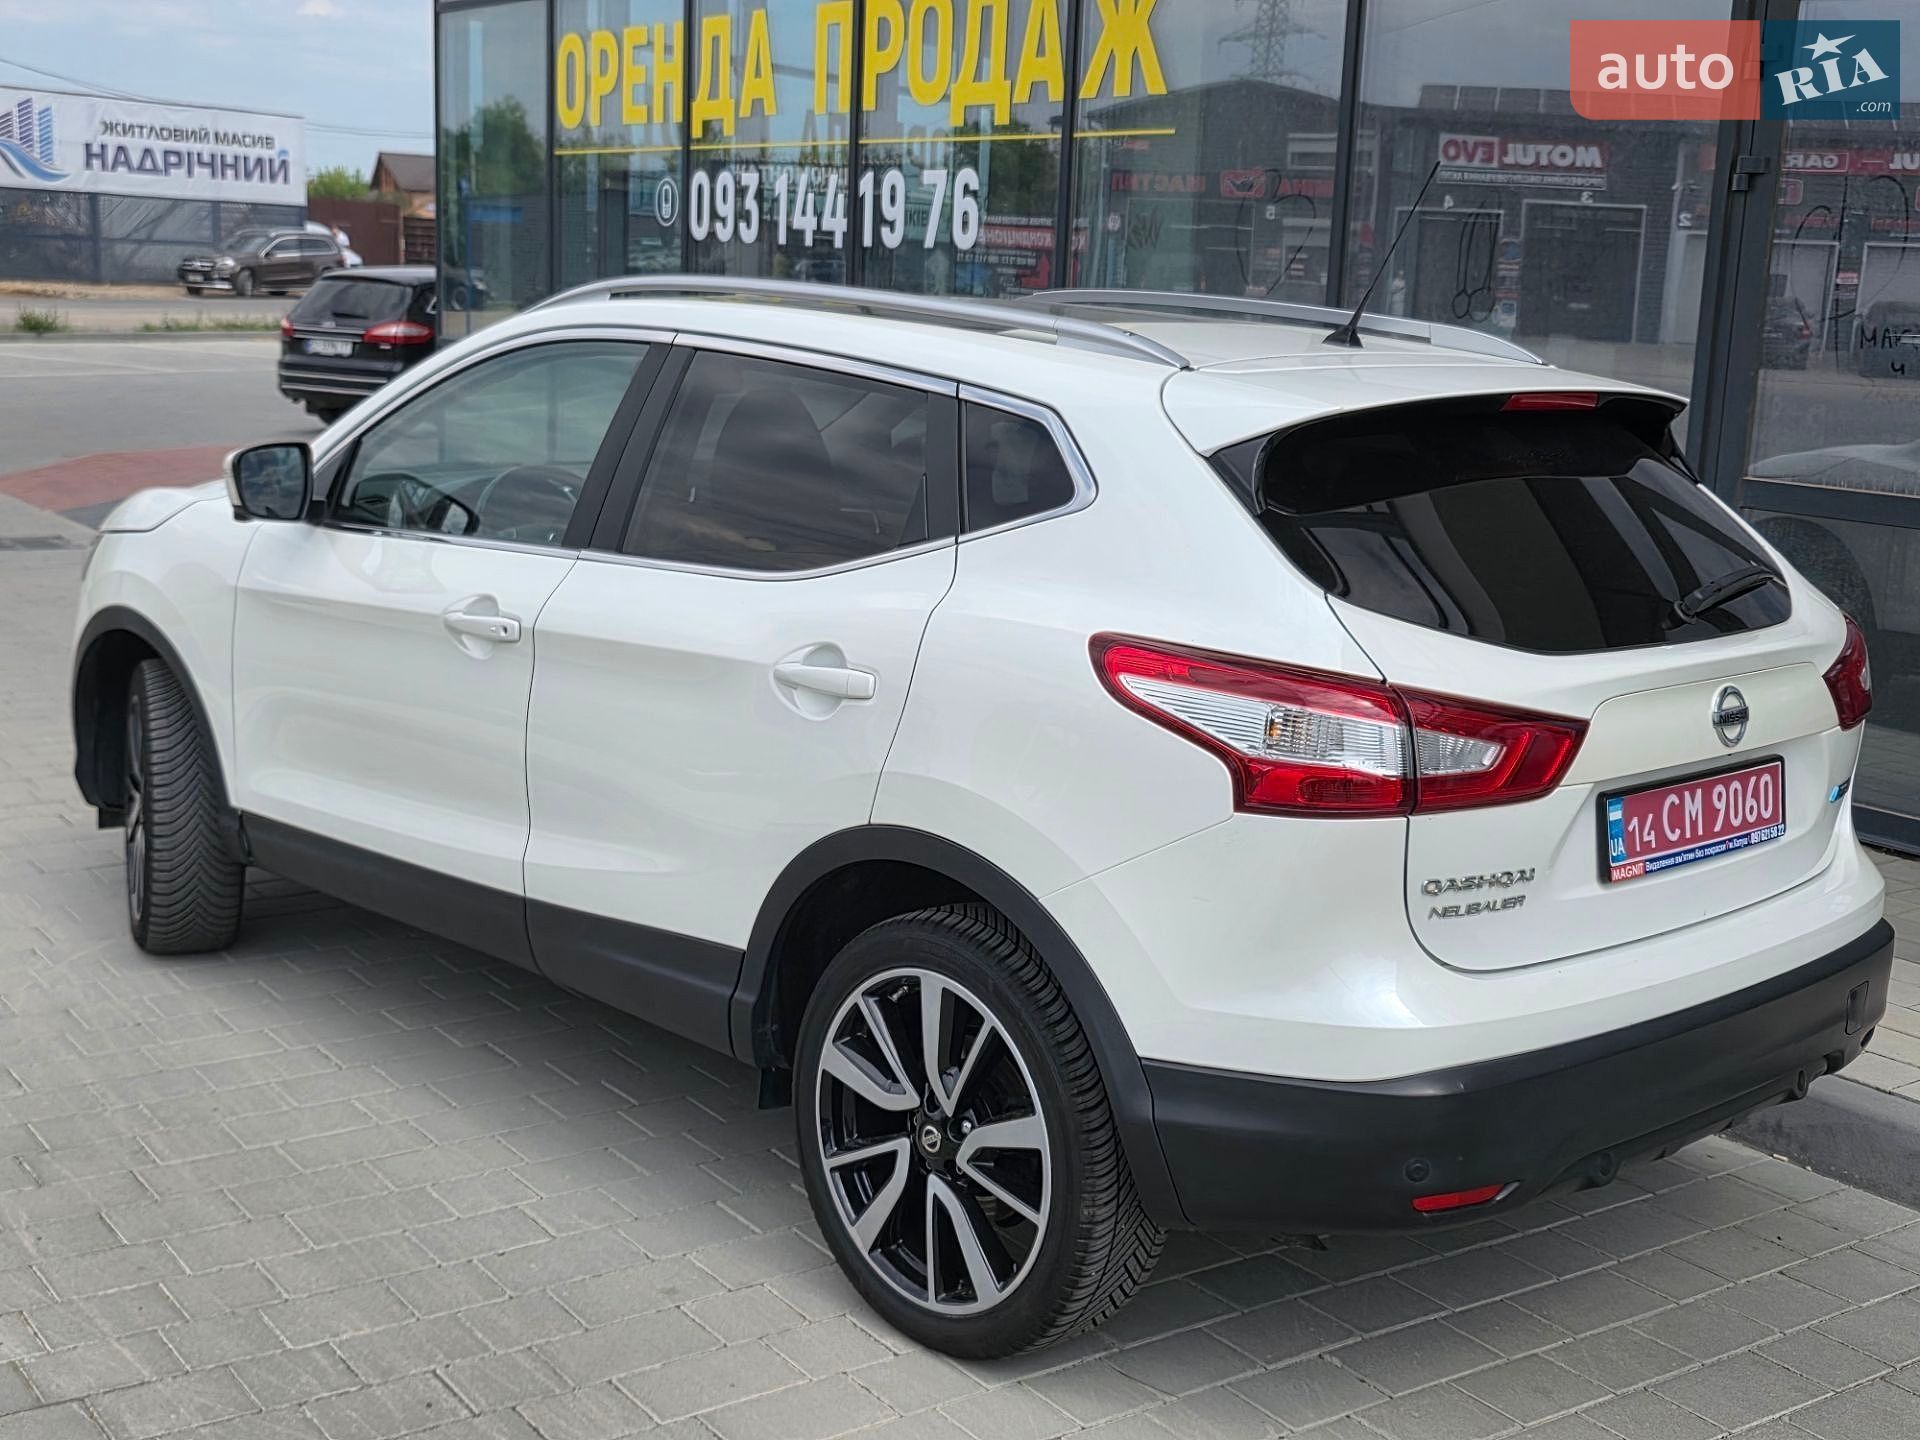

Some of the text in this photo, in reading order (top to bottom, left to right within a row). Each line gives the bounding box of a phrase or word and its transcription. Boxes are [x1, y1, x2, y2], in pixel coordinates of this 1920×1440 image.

[556, 0, 1168, 139] ОРЕНДА ПРОДАЖ
[101, 119, 275, 150] ЖИТЛОВИЙ МАСИВ
[85, 142, 291, 185] НАДРІЧНИЙ
[689, 170, 761, 244] 093
[775, 172, 848, 249] 144
[858, 167, 906, 250] 19
[922, 167, 980, 250] 76
[1627, 813, 1656, 852] 14
[1712, 773, 1774, 833] 9060
[1610, 838, 1626, 857] UA
[1612, 863, 1645, 881] MAGNIT
